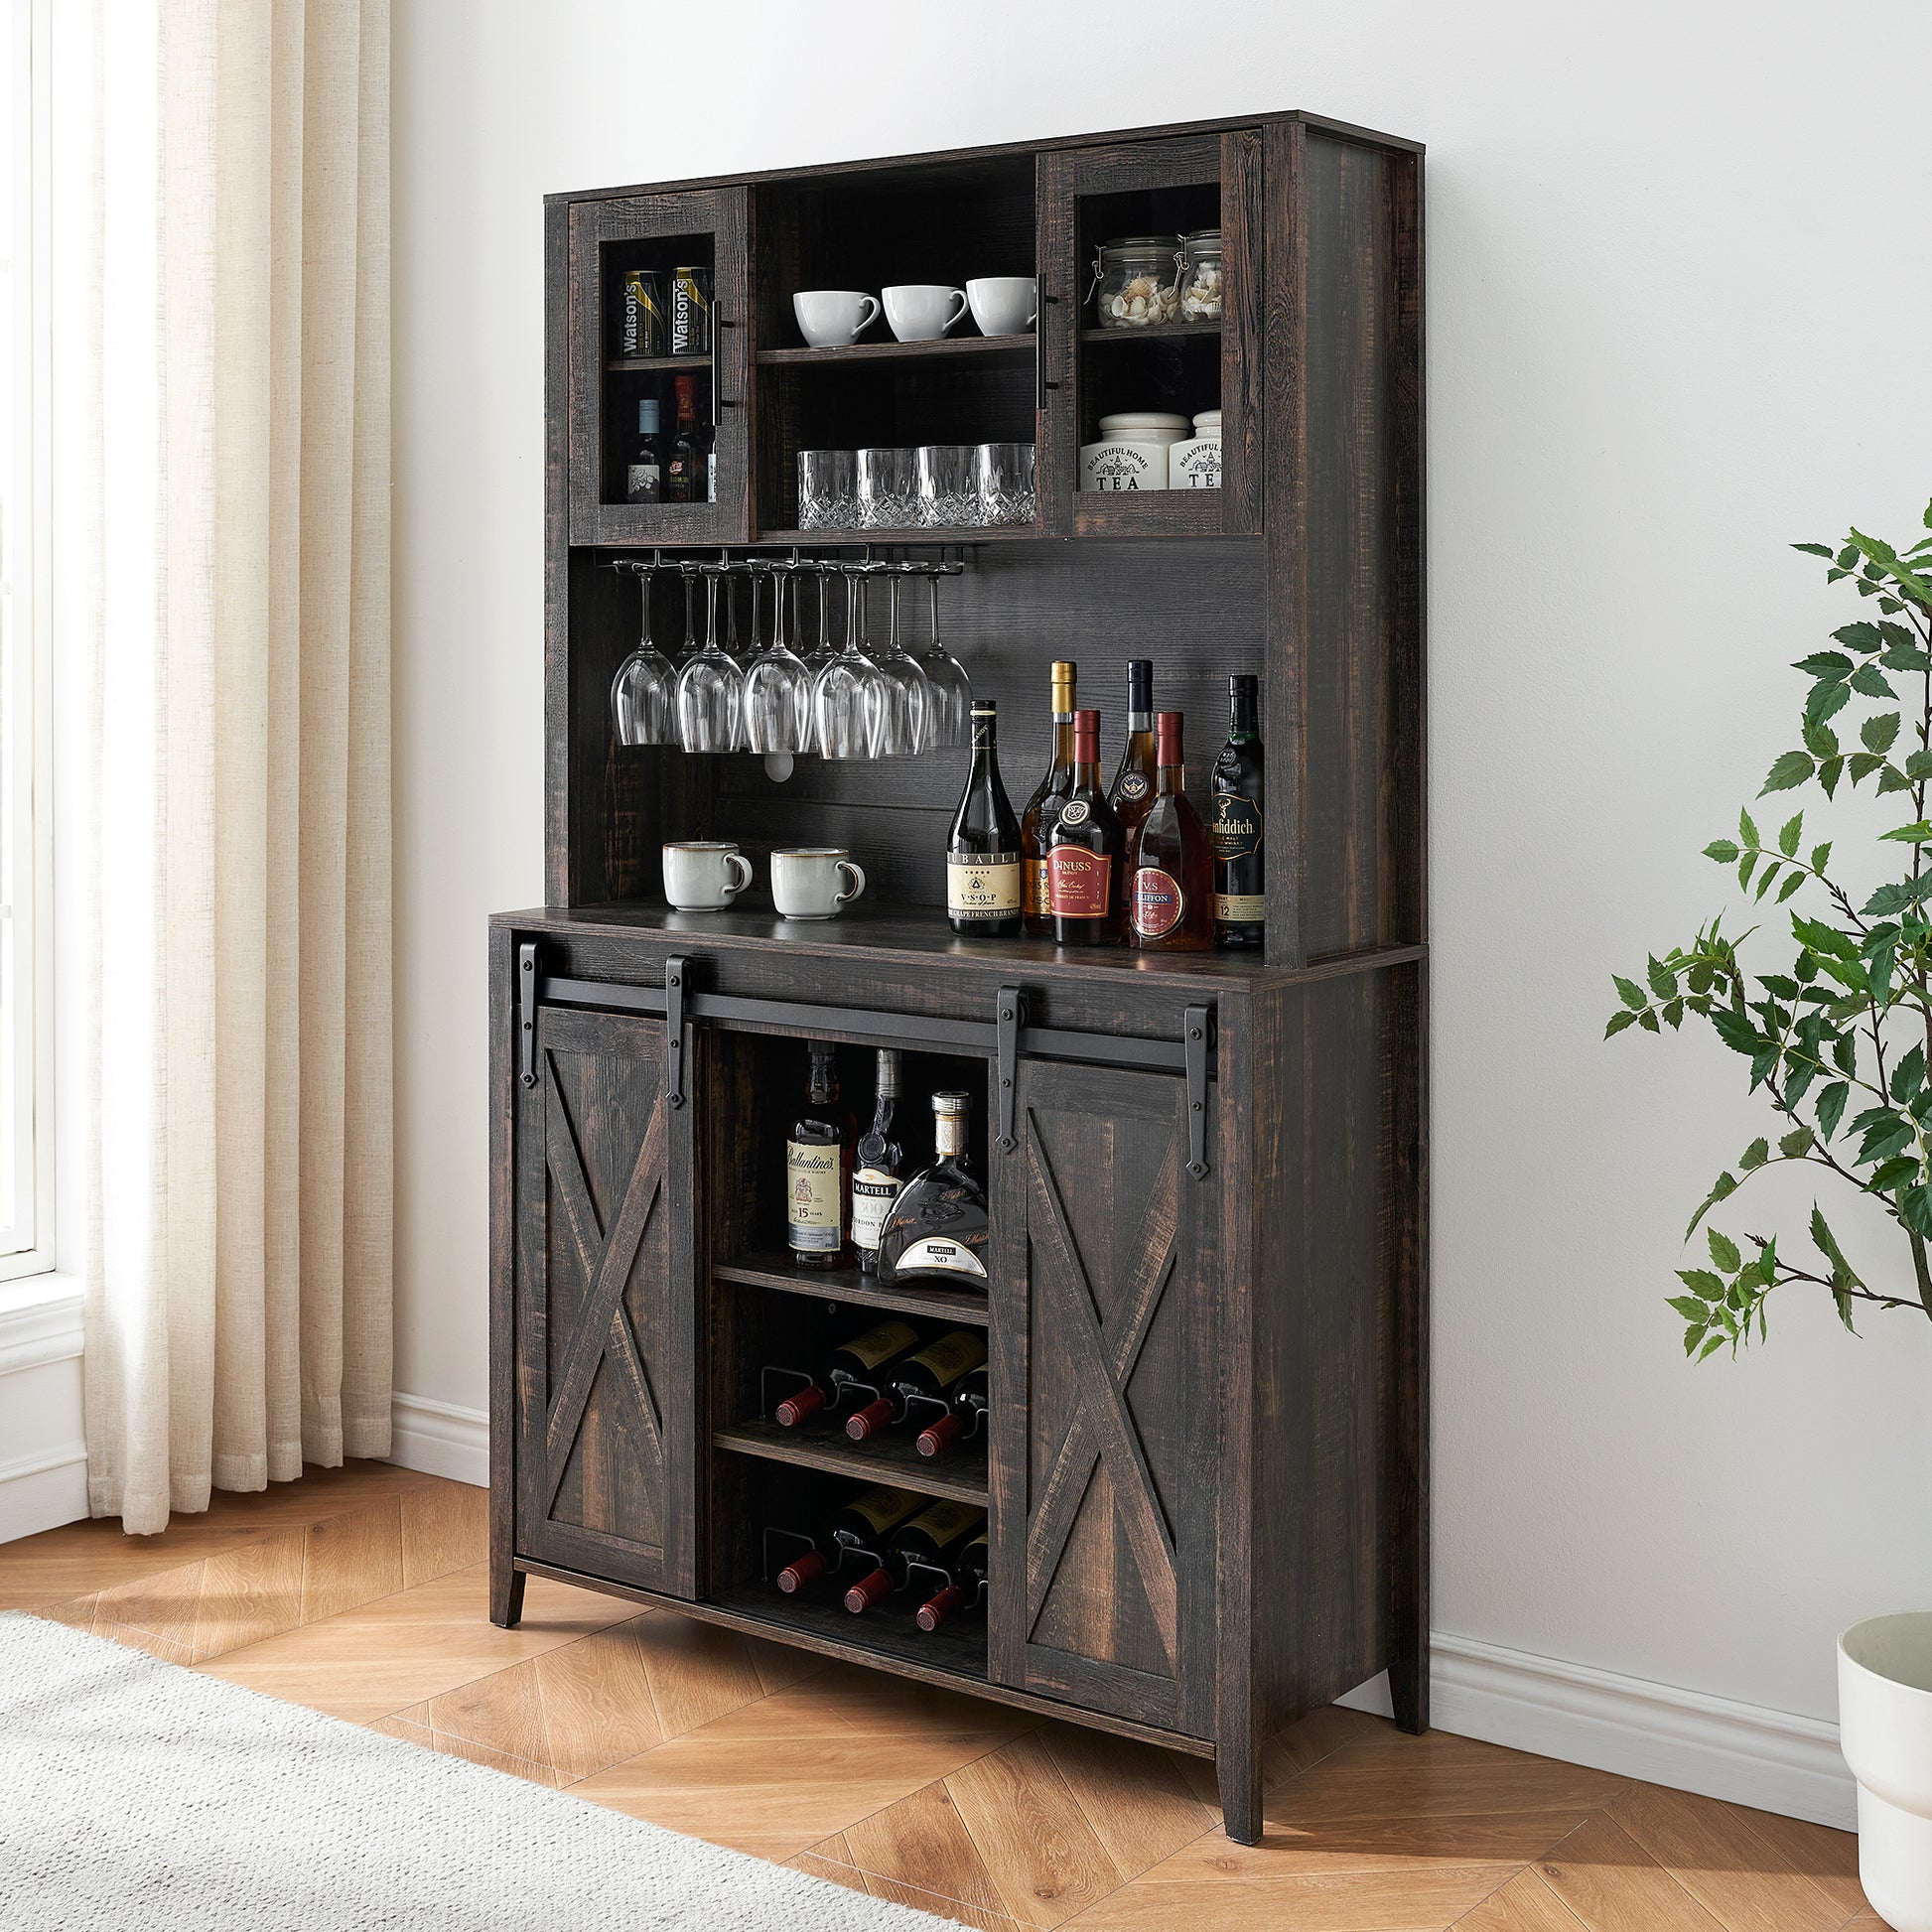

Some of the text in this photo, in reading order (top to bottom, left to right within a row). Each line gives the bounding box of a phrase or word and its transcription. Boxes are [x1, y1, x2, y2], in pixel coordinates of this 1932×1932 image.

[623, 284, 637, 352] Watson's
[674, 279, 689, 351] Watson's
[1087, 447, 1149, 472] BEAUTIFUL HOME
[1178, 443, 1218, 468] BEAUTIFUL
[1095, 476, 1139, 491] TEA
[1188, 473, 1221, 488] TE
[1212, 818, 1253, 835] nfiddich
[972, 909, 999, 918] FRENCH
[1220, 905, 1230, 916] 12
[855, 1182, 892, 1196] MARTELL
[798, 1207, 809, 1218] 15
[928, 1246, 953, 1255] MARTELL
[934, 1255, 948, 1264] XO
